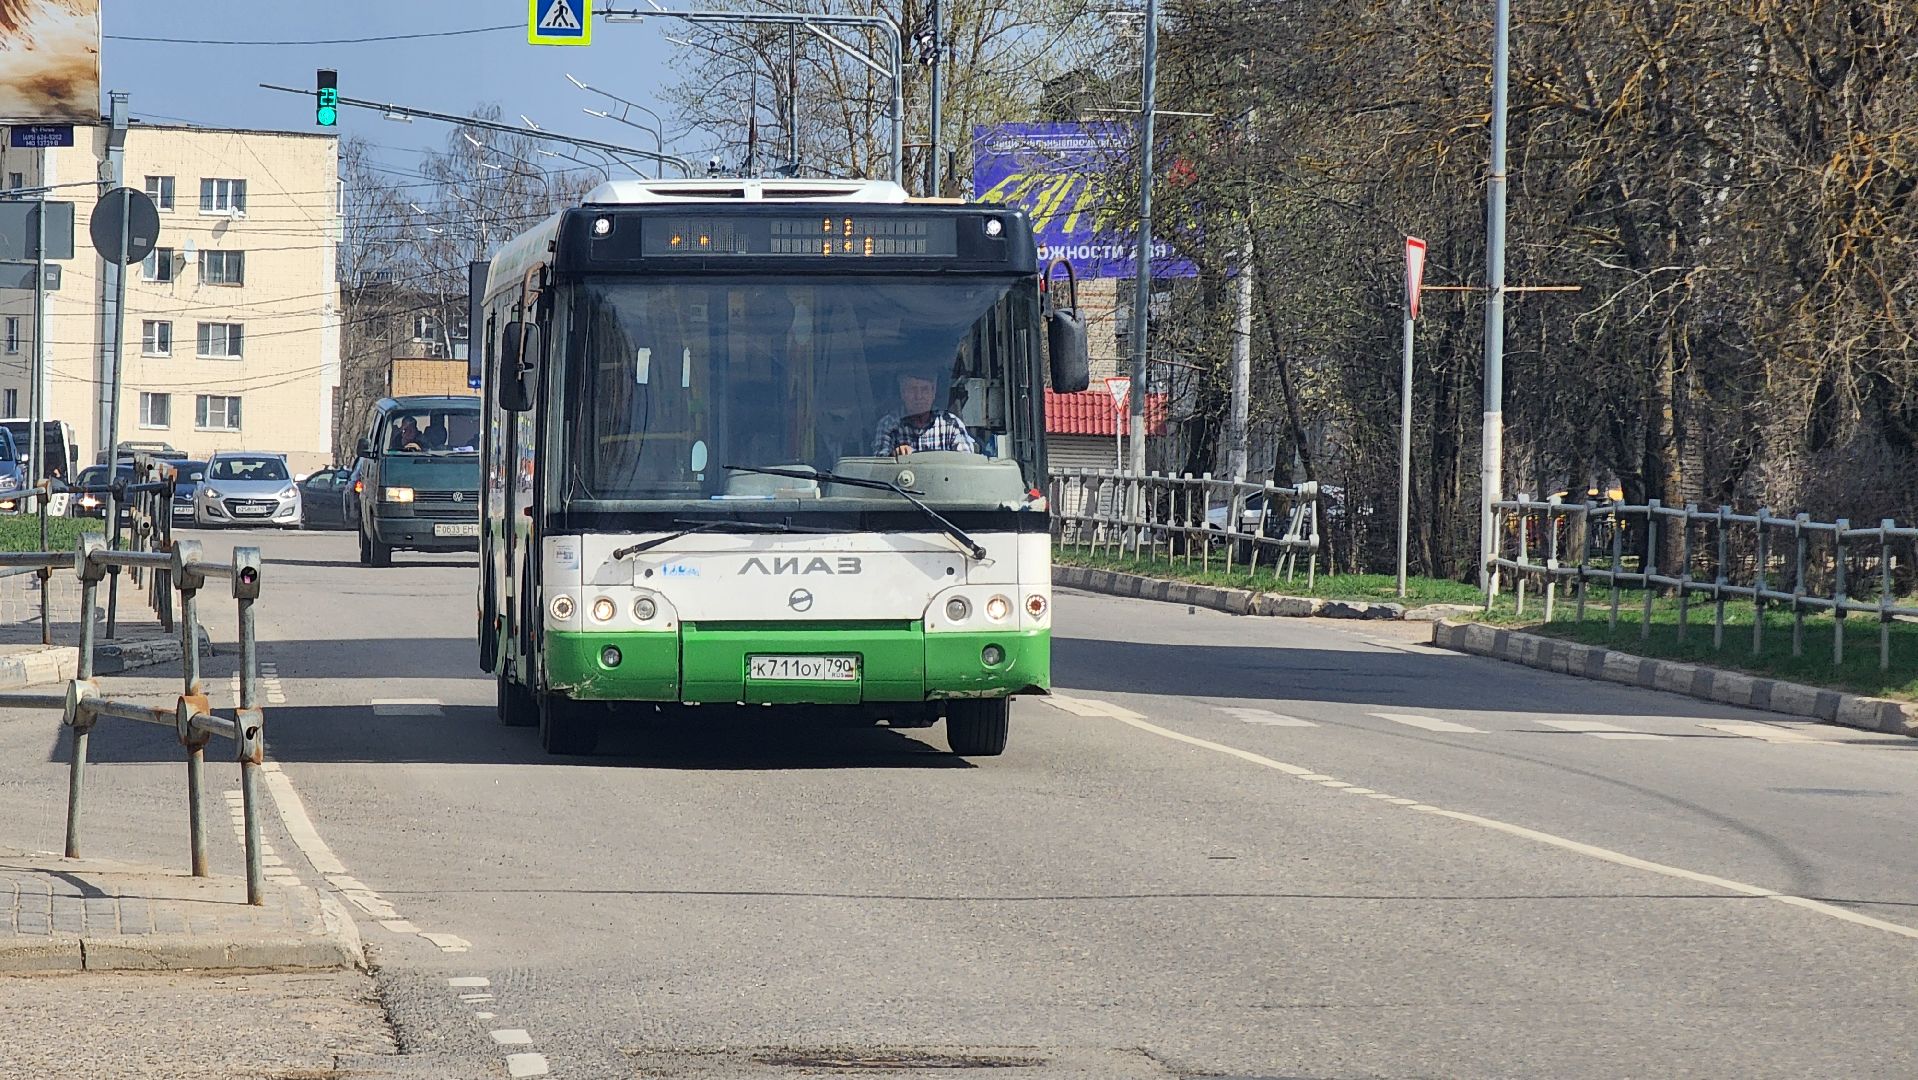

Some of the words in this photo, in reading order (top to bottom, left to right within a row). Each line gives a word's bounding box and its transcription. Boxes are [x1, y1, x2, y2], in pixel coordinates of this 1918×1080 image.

[321, 88, 337, 105] 23
[1036, 244, 1123, 260] ОЖНОСТИ
[738, 557, 862, 575] ЛИАЗ
[826, 659, 851, 672] 790
